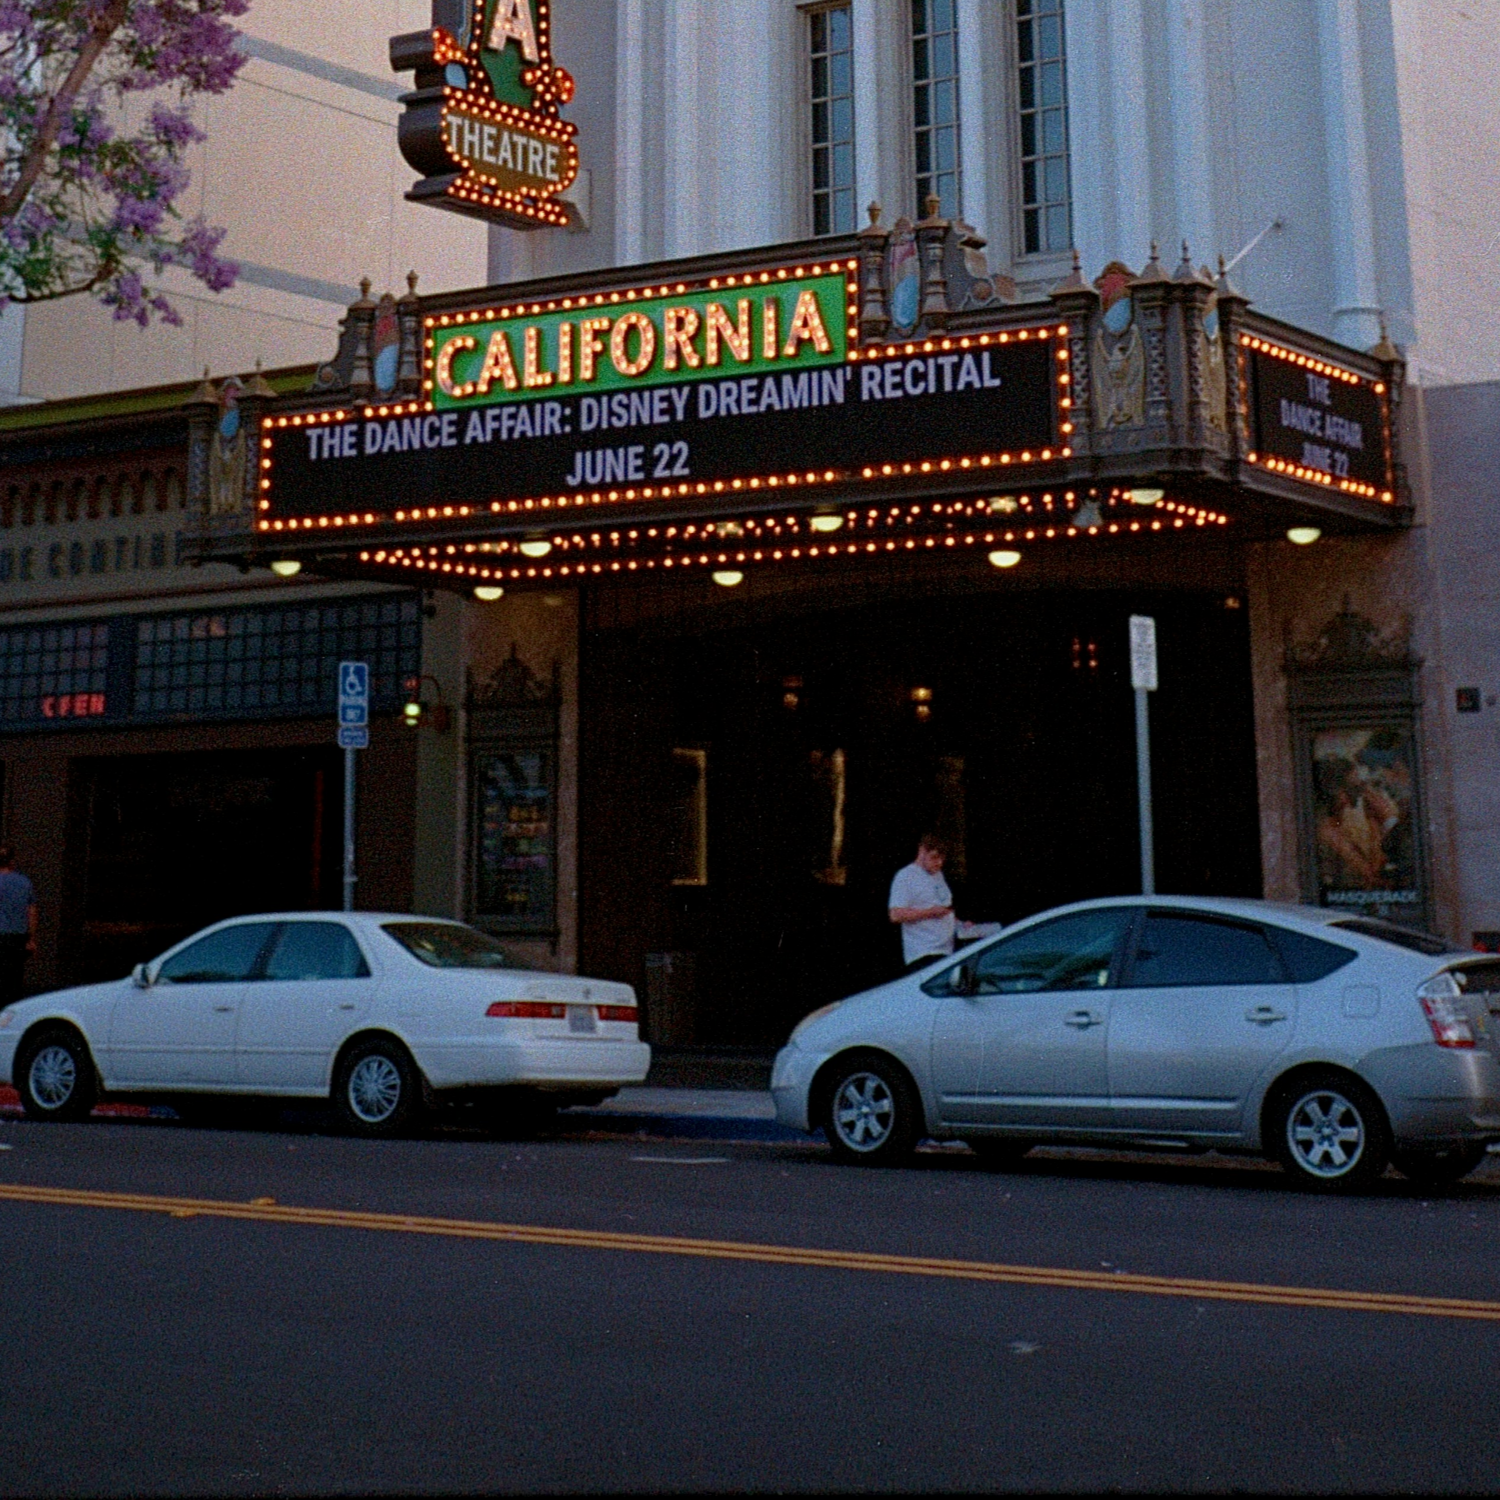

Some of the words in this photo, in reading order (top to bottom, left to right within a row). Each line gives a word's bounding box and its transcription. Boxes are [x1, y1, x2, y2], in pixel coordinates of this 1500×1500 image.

[446, 114, 560, 182] THEATRE
[435, 289, 831, 398] CALIFORNIA
[305, 426, 358, 460] THE
[364, 414, 458, 454] DANCE
[464, 402, 572, 444] AFFAIR:
[580, 386, 690, 432] DISNEY
[699, 366, 853, 419] DREAMIN'
[861, 351, 1001, 401] RECITAL
[1306, 373, 1331, 405] THE
[1281, 398, 1322, 436] DANCE
[1325, 414, 1363, 449] AFFAIR
[565, 445, 646, 487] JUNE
[653, 441, 690, 478] 22
[1302, 441, 1332, 473] JUNE
[1333, 450, 1349, 477] 22
[1326, 890, 1418, 903] MASQUERADE
